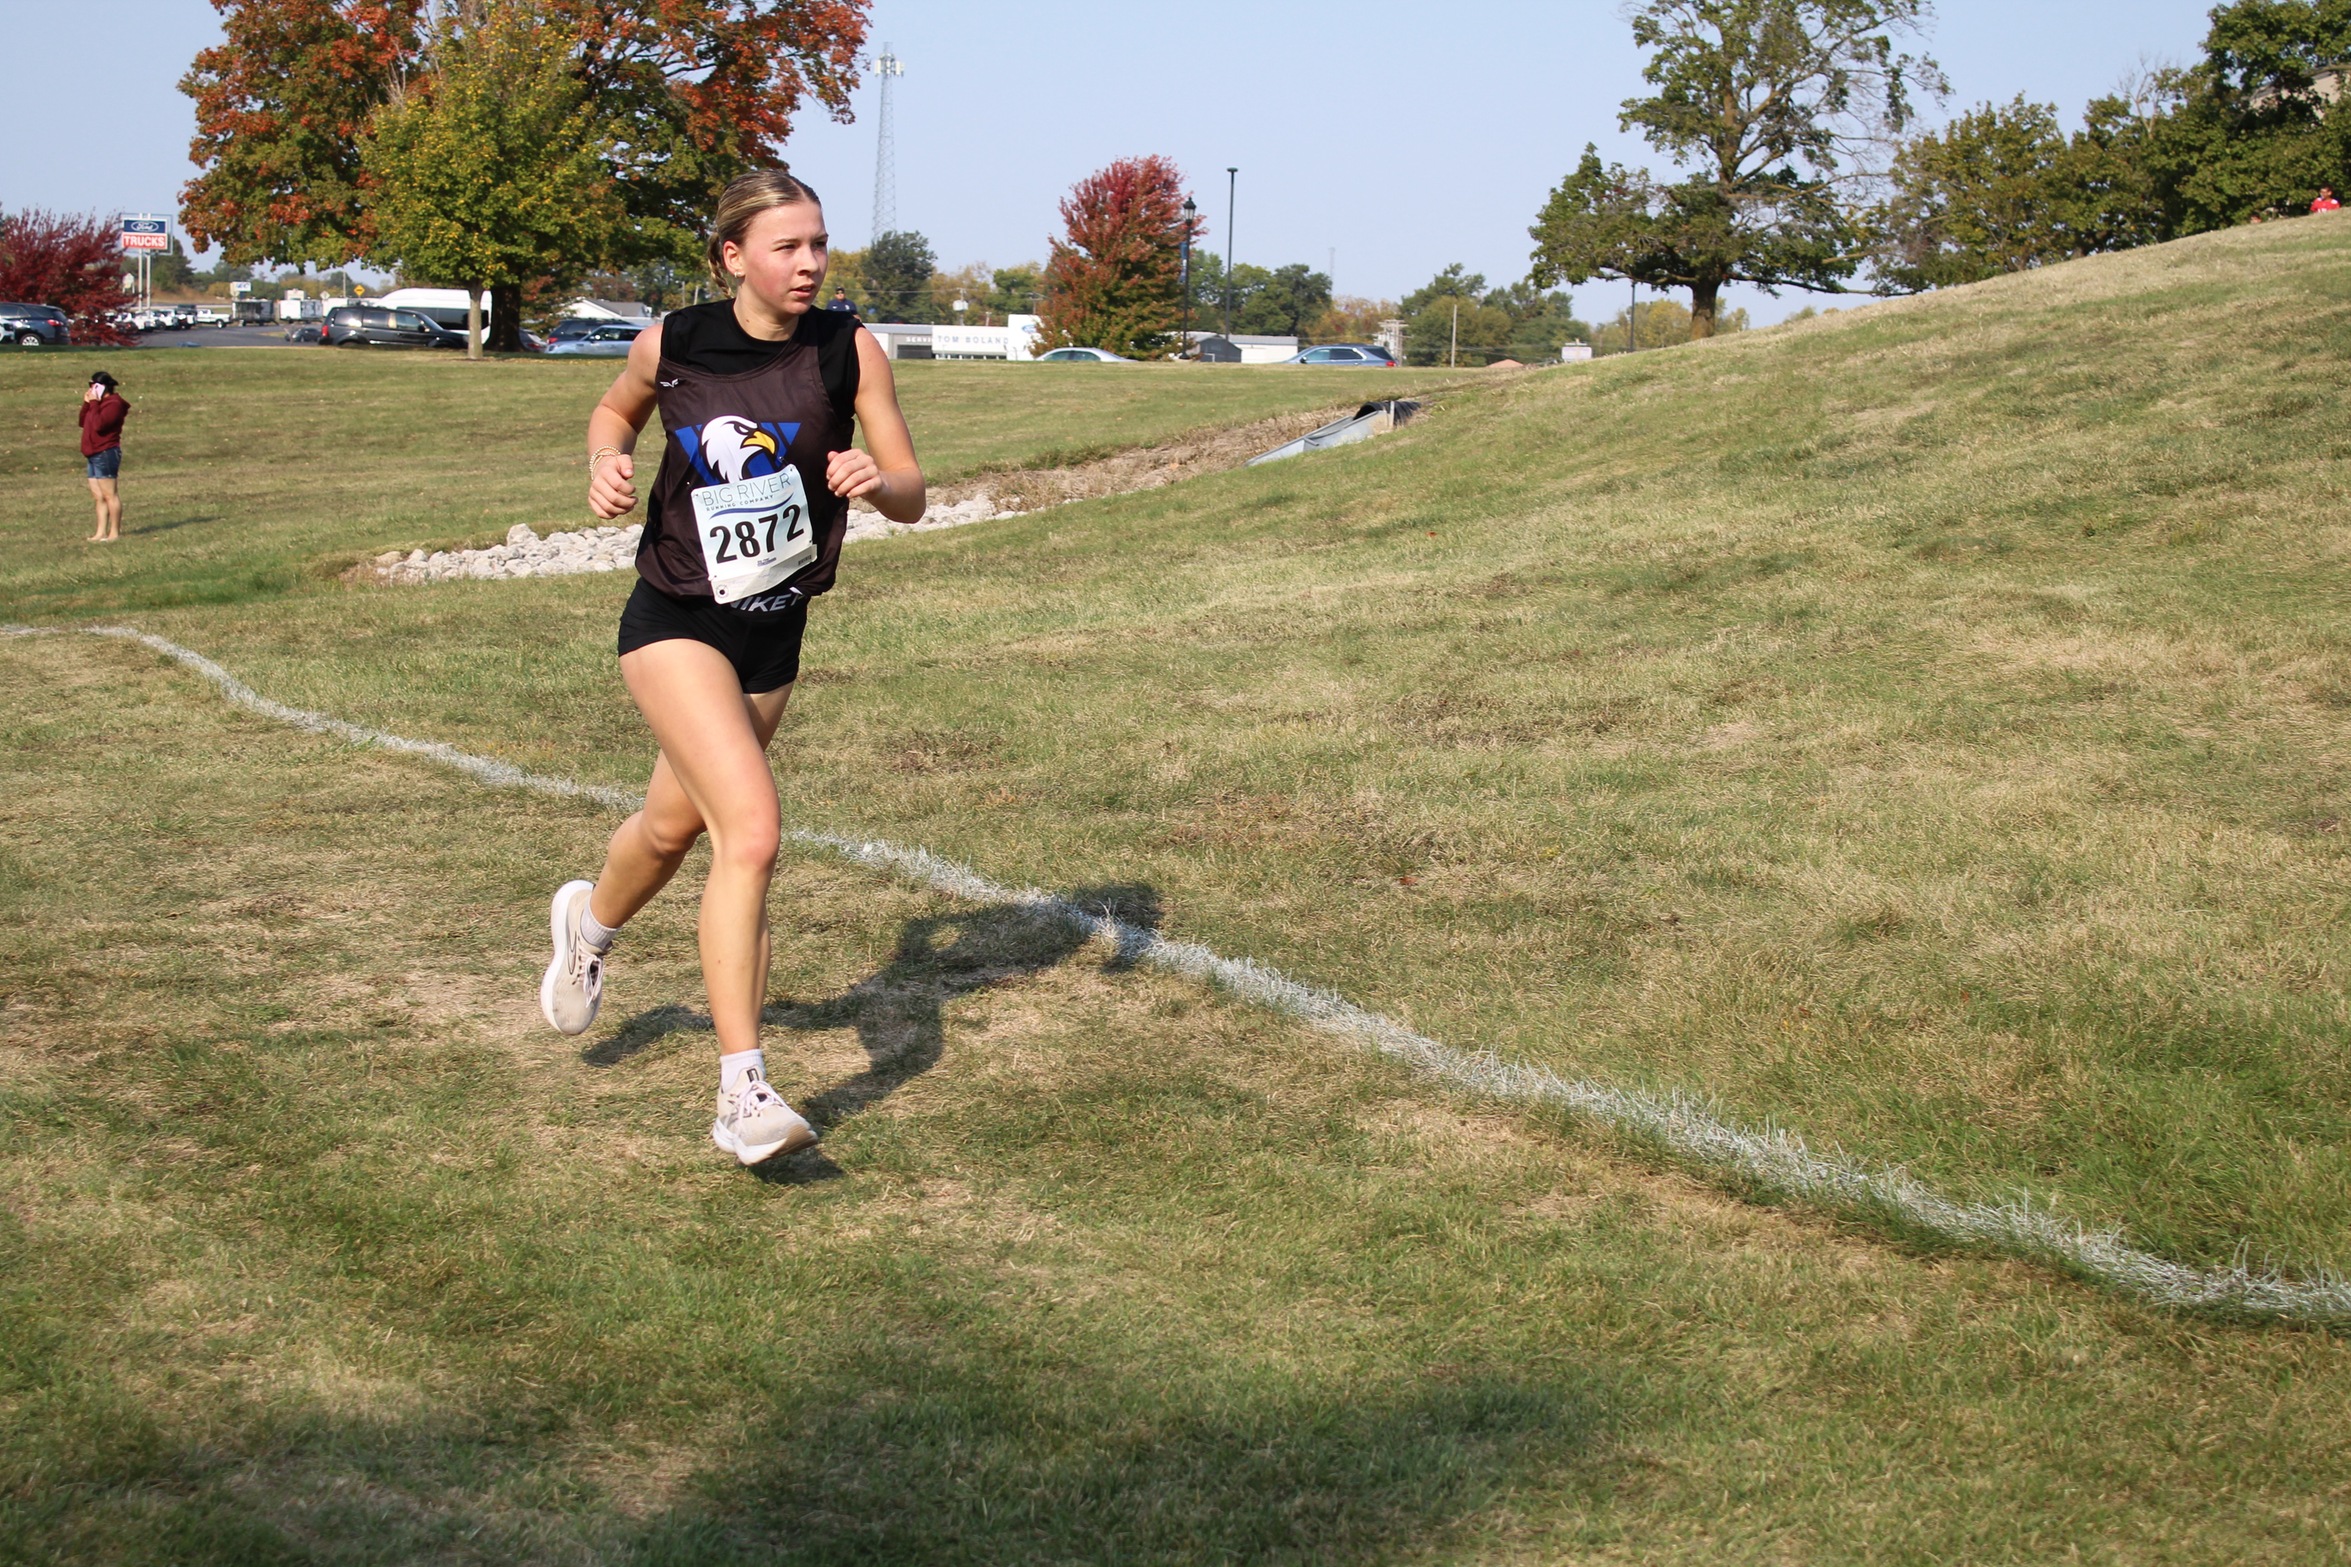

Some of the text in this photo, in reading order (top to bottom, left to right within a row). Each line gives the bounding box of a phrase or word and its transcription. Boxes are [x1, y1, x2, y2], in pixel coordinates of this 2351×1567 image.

[124, 235, 165, 247] TRUCKS
[937, 335, 1009, 345] TOM BOLAND
[702, 473, 791, 507] BIG RIVER
[706, 494, 774, 512] RUNNING COMPANY
[709, 504, 804, 564] 2872
